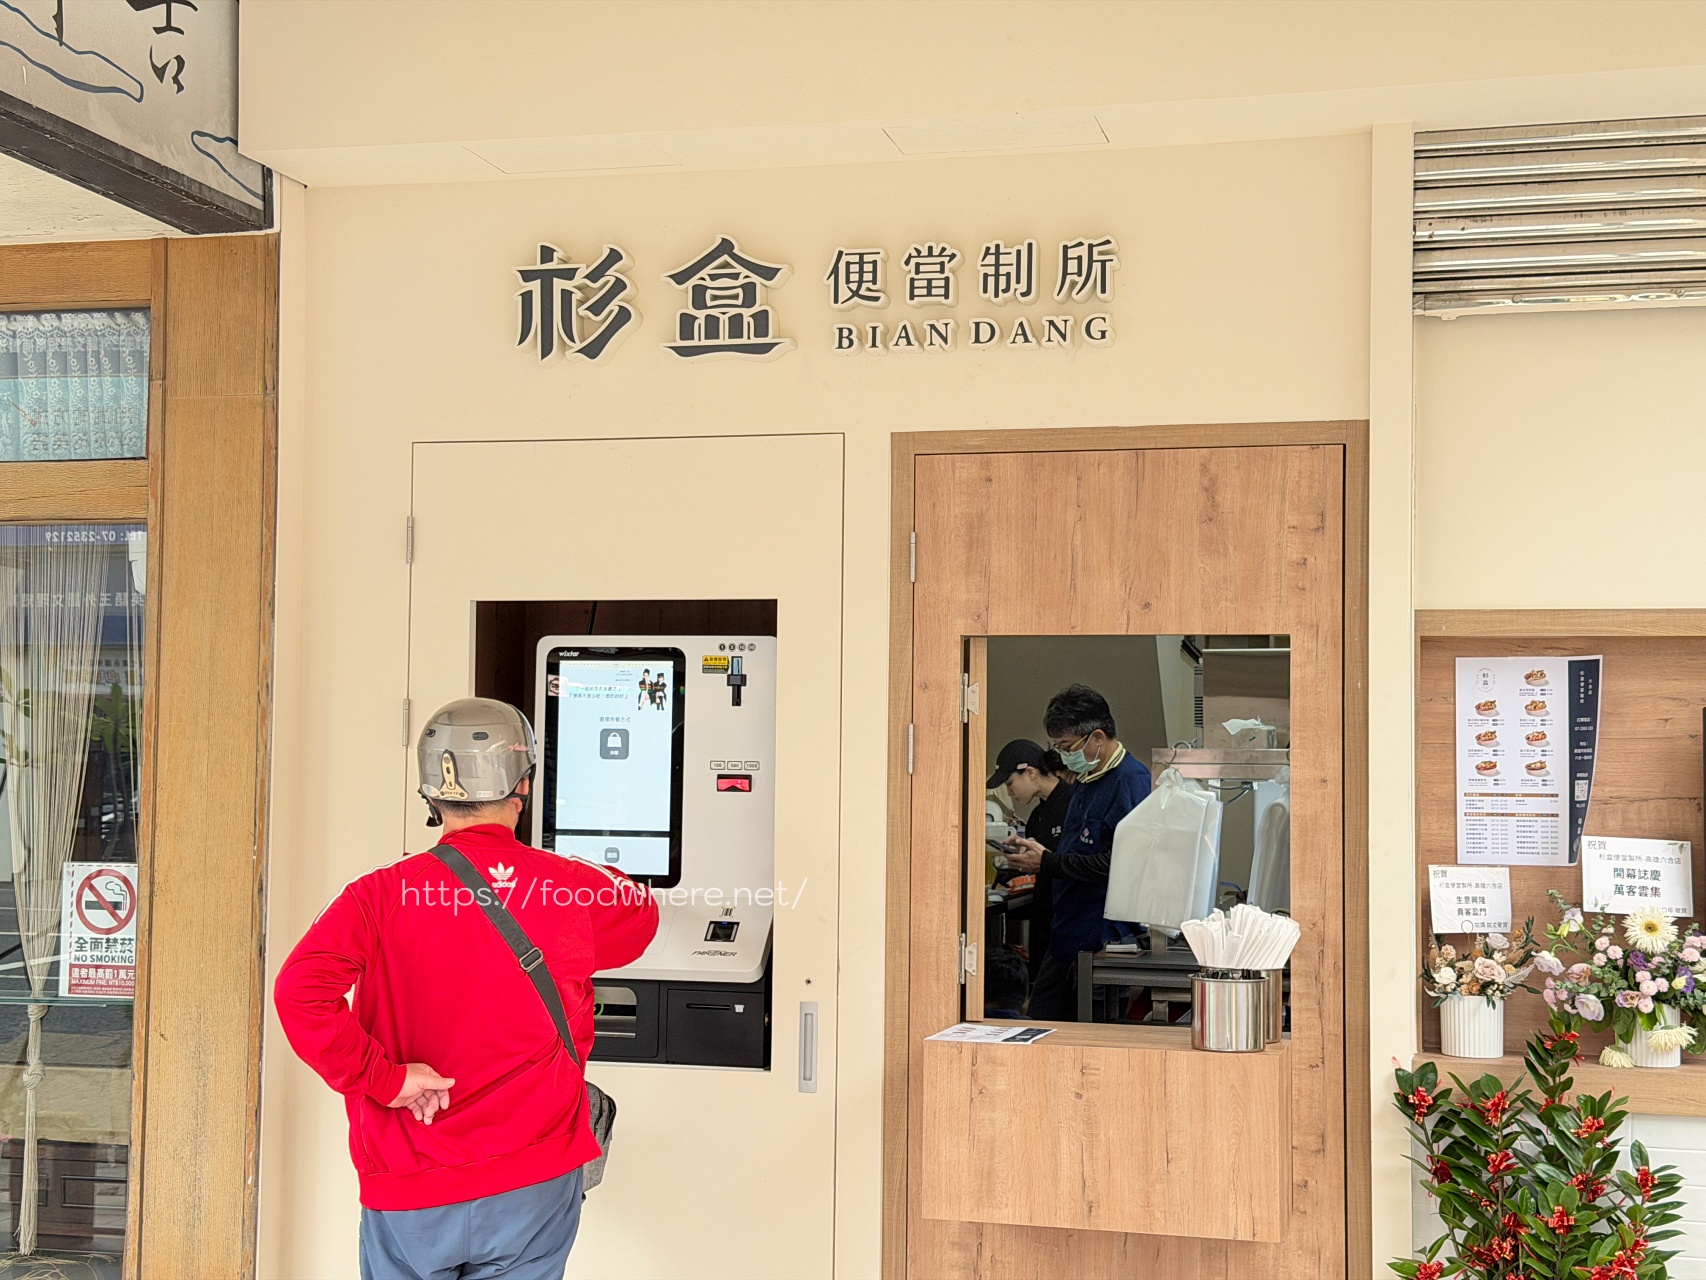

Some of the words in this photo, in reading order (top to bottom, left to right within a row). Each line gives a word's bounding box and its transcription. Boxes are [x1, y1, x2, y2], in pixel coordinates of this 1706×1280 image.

[826, 239, 1114, 305] 便當制所
[516, 237, 786, 362] 杉盒
[835, 321, 951, 350] BIAN
[971, 315, 1108, 345] DANG
[1587, 840, 1607, 851] 祝賀
[1613, 867, 1662, 882] 開幕誌慶
[1613, 884, 1662, 898] 萬客雲集
[1456, 896, 1487, 905] 生意興隆
[75, 936, 135, 954] 全面禁菸
[74, 954, 88, 963] NO
[90, 955, 135, 964] SMOKING
